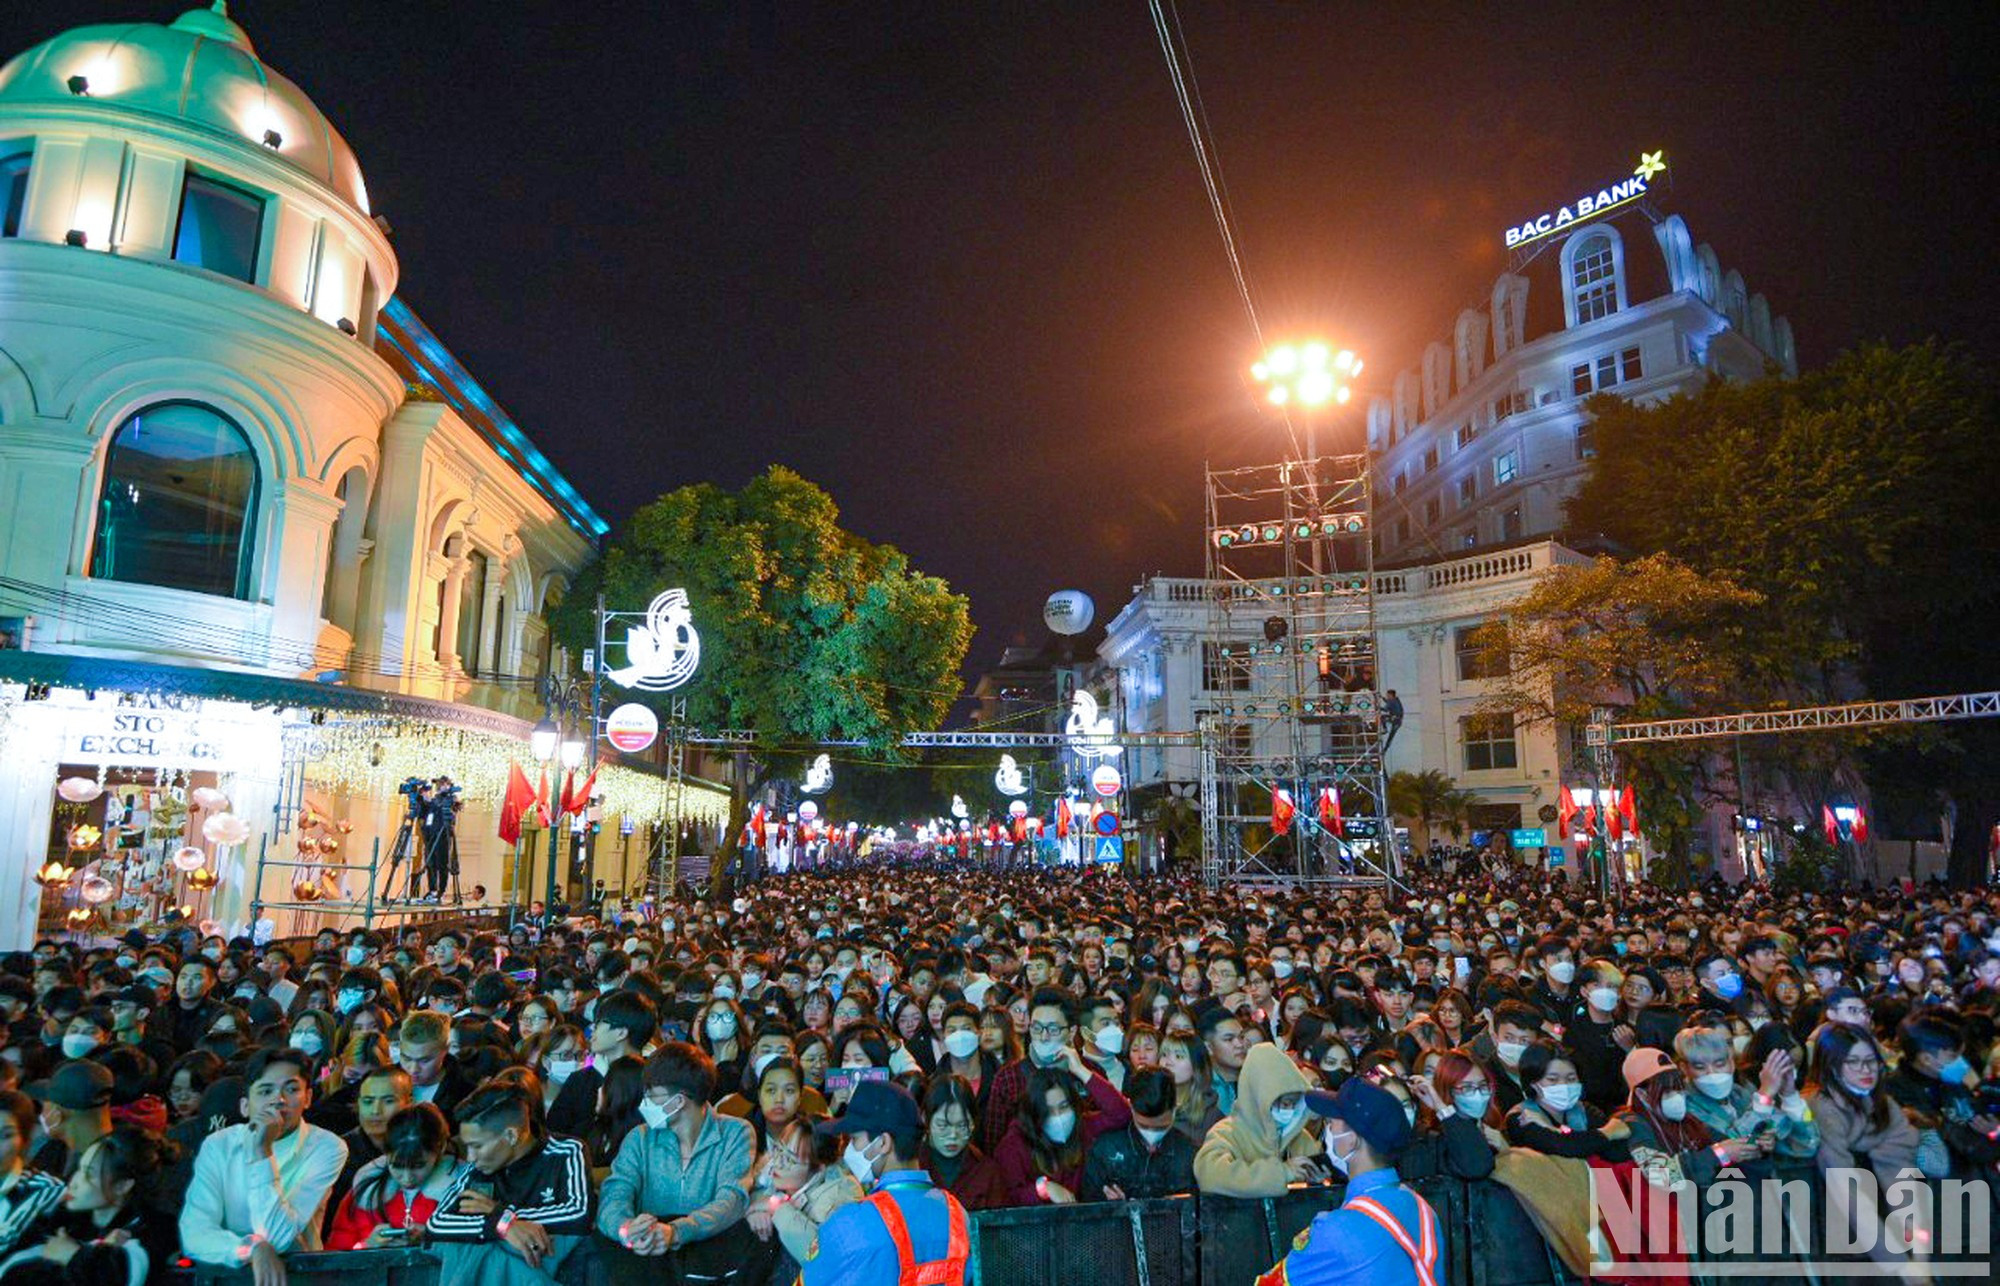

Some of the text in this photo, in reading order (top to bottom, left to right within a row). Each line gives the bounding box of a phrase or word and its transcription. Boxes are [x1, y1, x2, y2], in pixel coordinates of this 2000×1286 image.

[1505, 175, 1648, 246] BAC A BANK
